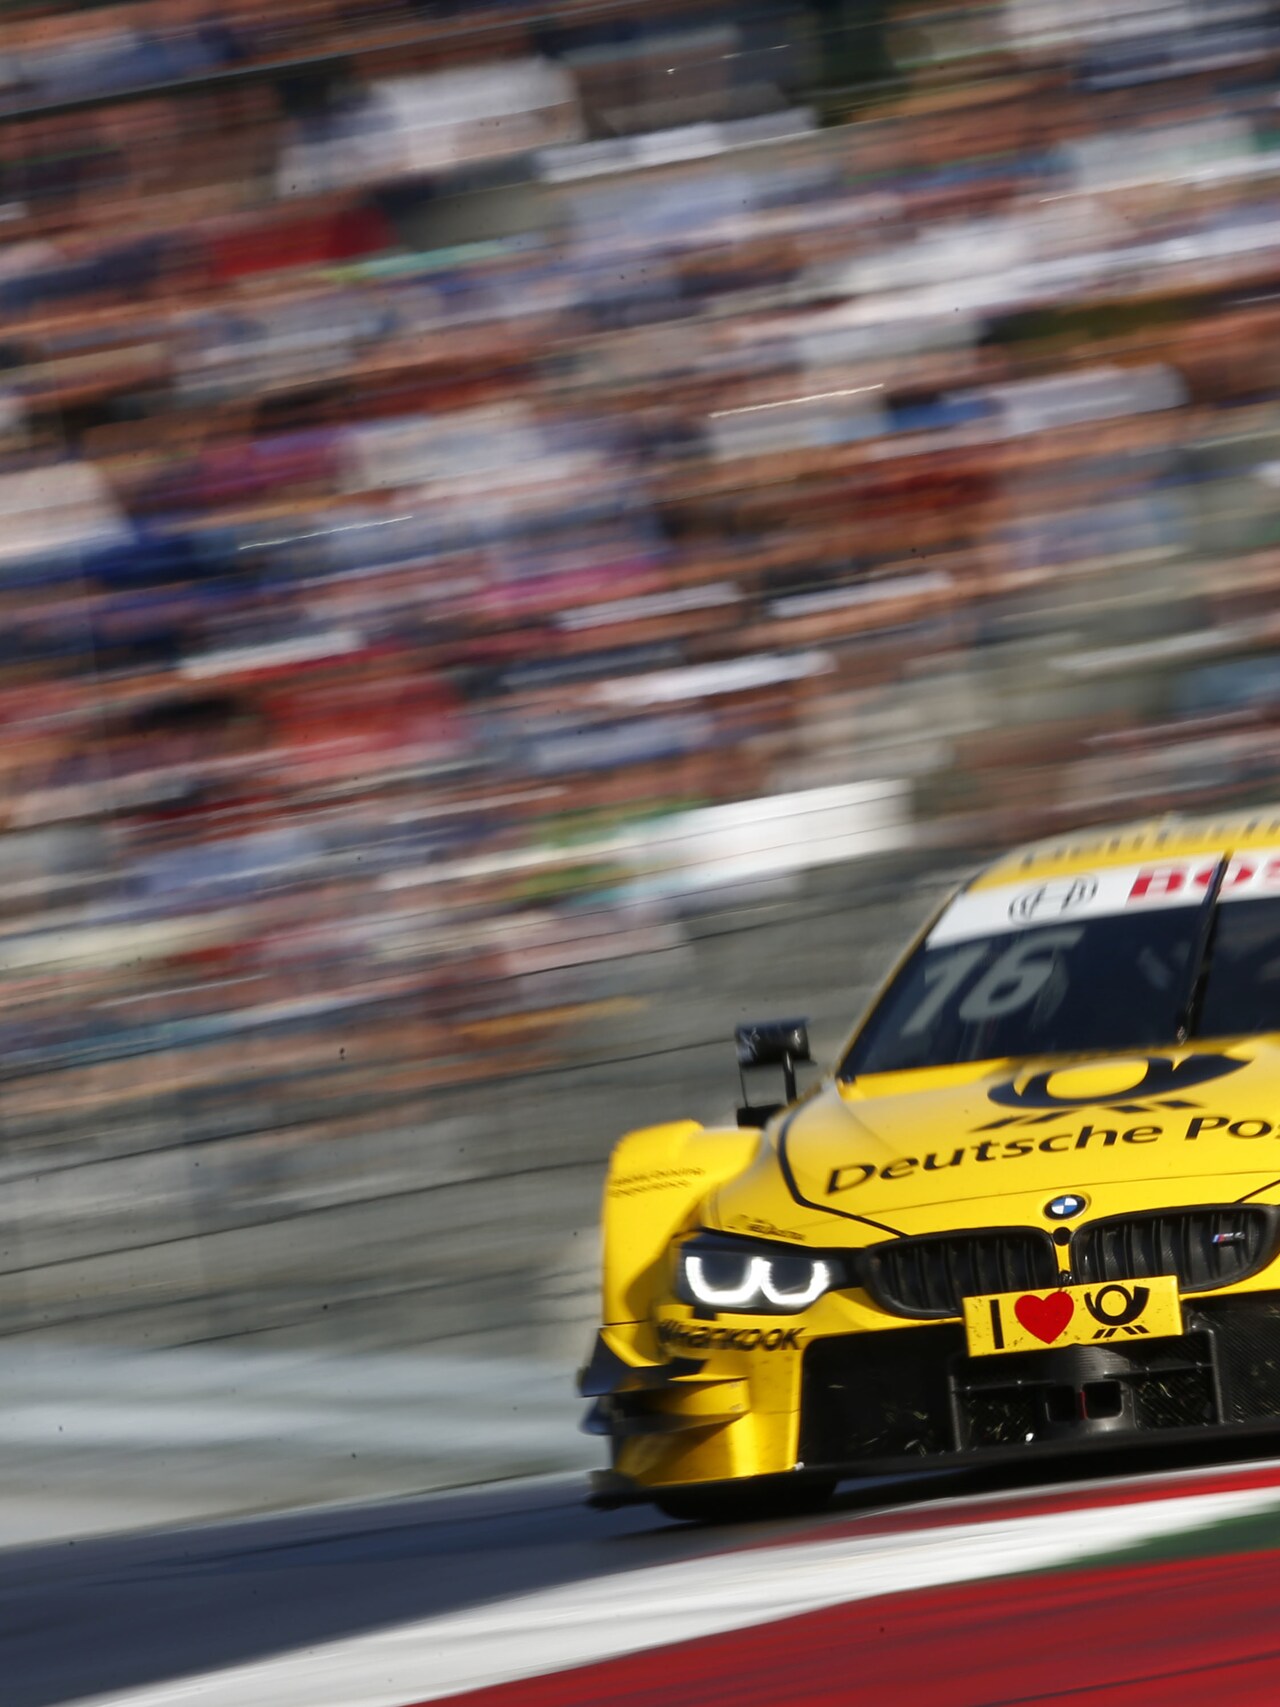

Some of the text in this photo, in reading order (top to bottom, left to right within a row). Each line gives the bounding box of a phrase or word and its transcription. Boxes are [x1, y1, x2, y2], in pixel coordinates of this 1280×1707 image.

[902, 927, 1086, 1036] 16
[824, 1124, 1164, 1197] Deutsche
[990, 1298, 1005, 1350] I
